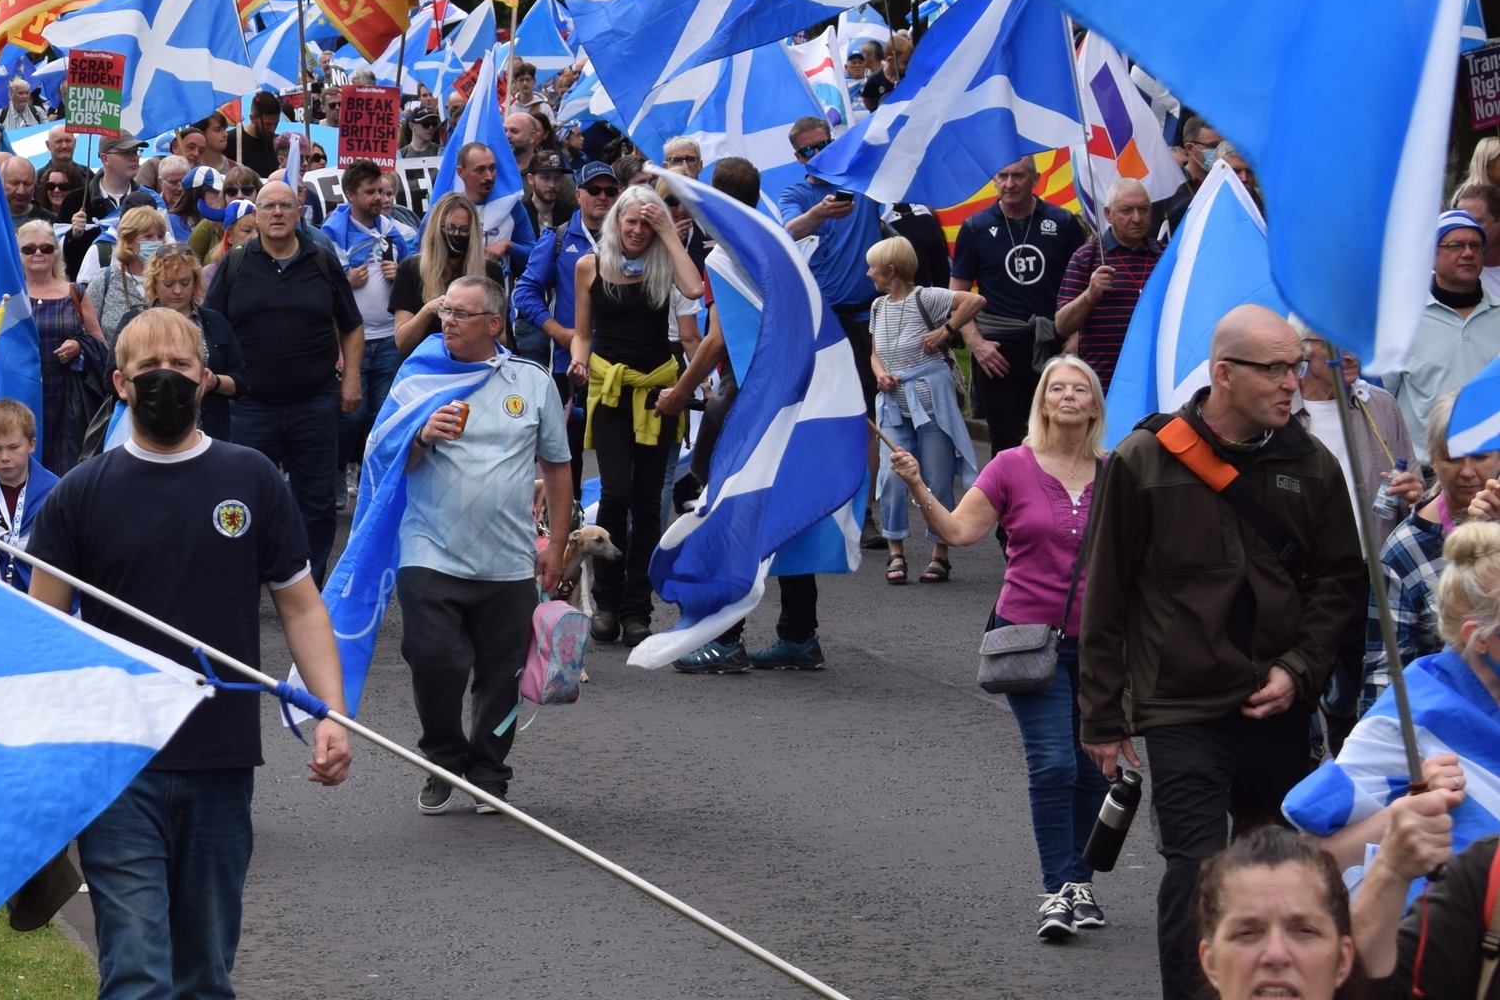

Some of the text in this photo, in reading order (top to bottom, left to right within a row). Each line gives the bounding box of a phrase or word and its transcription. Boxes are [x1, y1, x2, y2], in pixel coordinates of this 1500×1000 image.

[70, 58, 114, 73] SCRAP
[70, 71, 122, 88] TRIDENT
[69, 86, 105, 100] FUND
[68, 99, 121, 117] CLIMATE
[347, 97, 393, 112] BREAK
[67, 112, 102, 125] JOBS
[344, 111, 394, 126] UP THE
[341, 124, 395, 140] BRITISH
[346, 138, 389, 153] STATE
[340, 156, 354, 165] NO
[372, 157, 395, 167] WAR
[1014, 256, 1037, 273] BT
